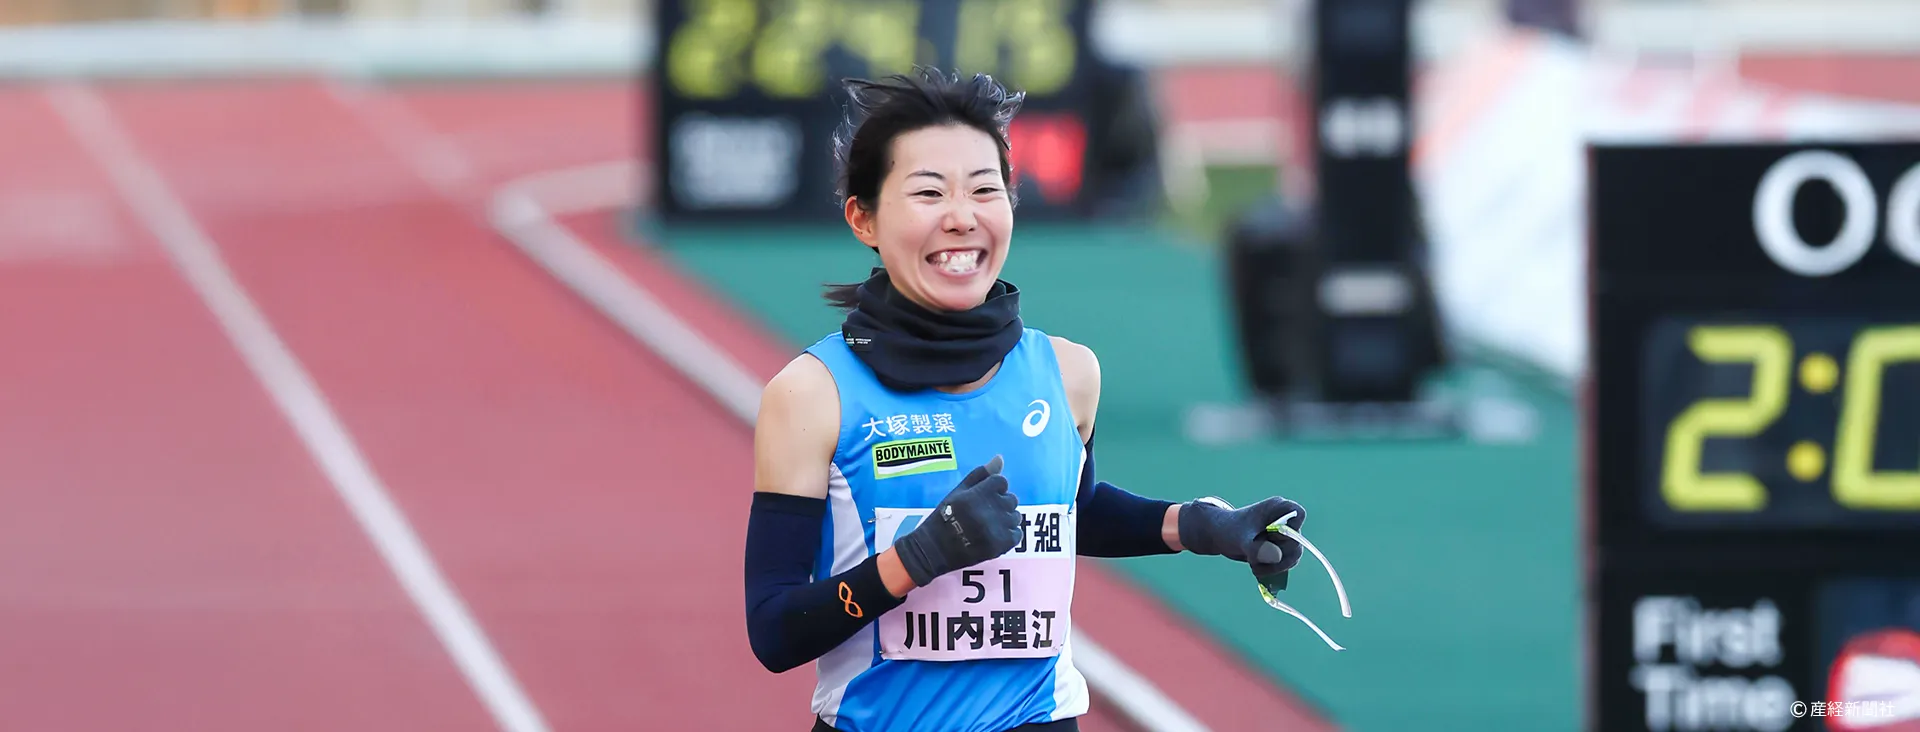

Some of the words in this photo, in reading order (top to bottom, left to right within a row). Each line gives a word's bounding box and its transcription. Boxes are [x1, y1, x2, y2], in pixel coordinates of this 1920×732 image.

[1753, 149, 1920, 276] O
[862, 413, 956, 441] 大塚製薬
[875, 440, 951, 462] BODYMAINTÉ
[962, 569, 1012, 603] 51
[904, 609, 1056, 651] 川内理江
[1633, 596, 1783, 667] First
[1629, 663, 1796, 732] Time
